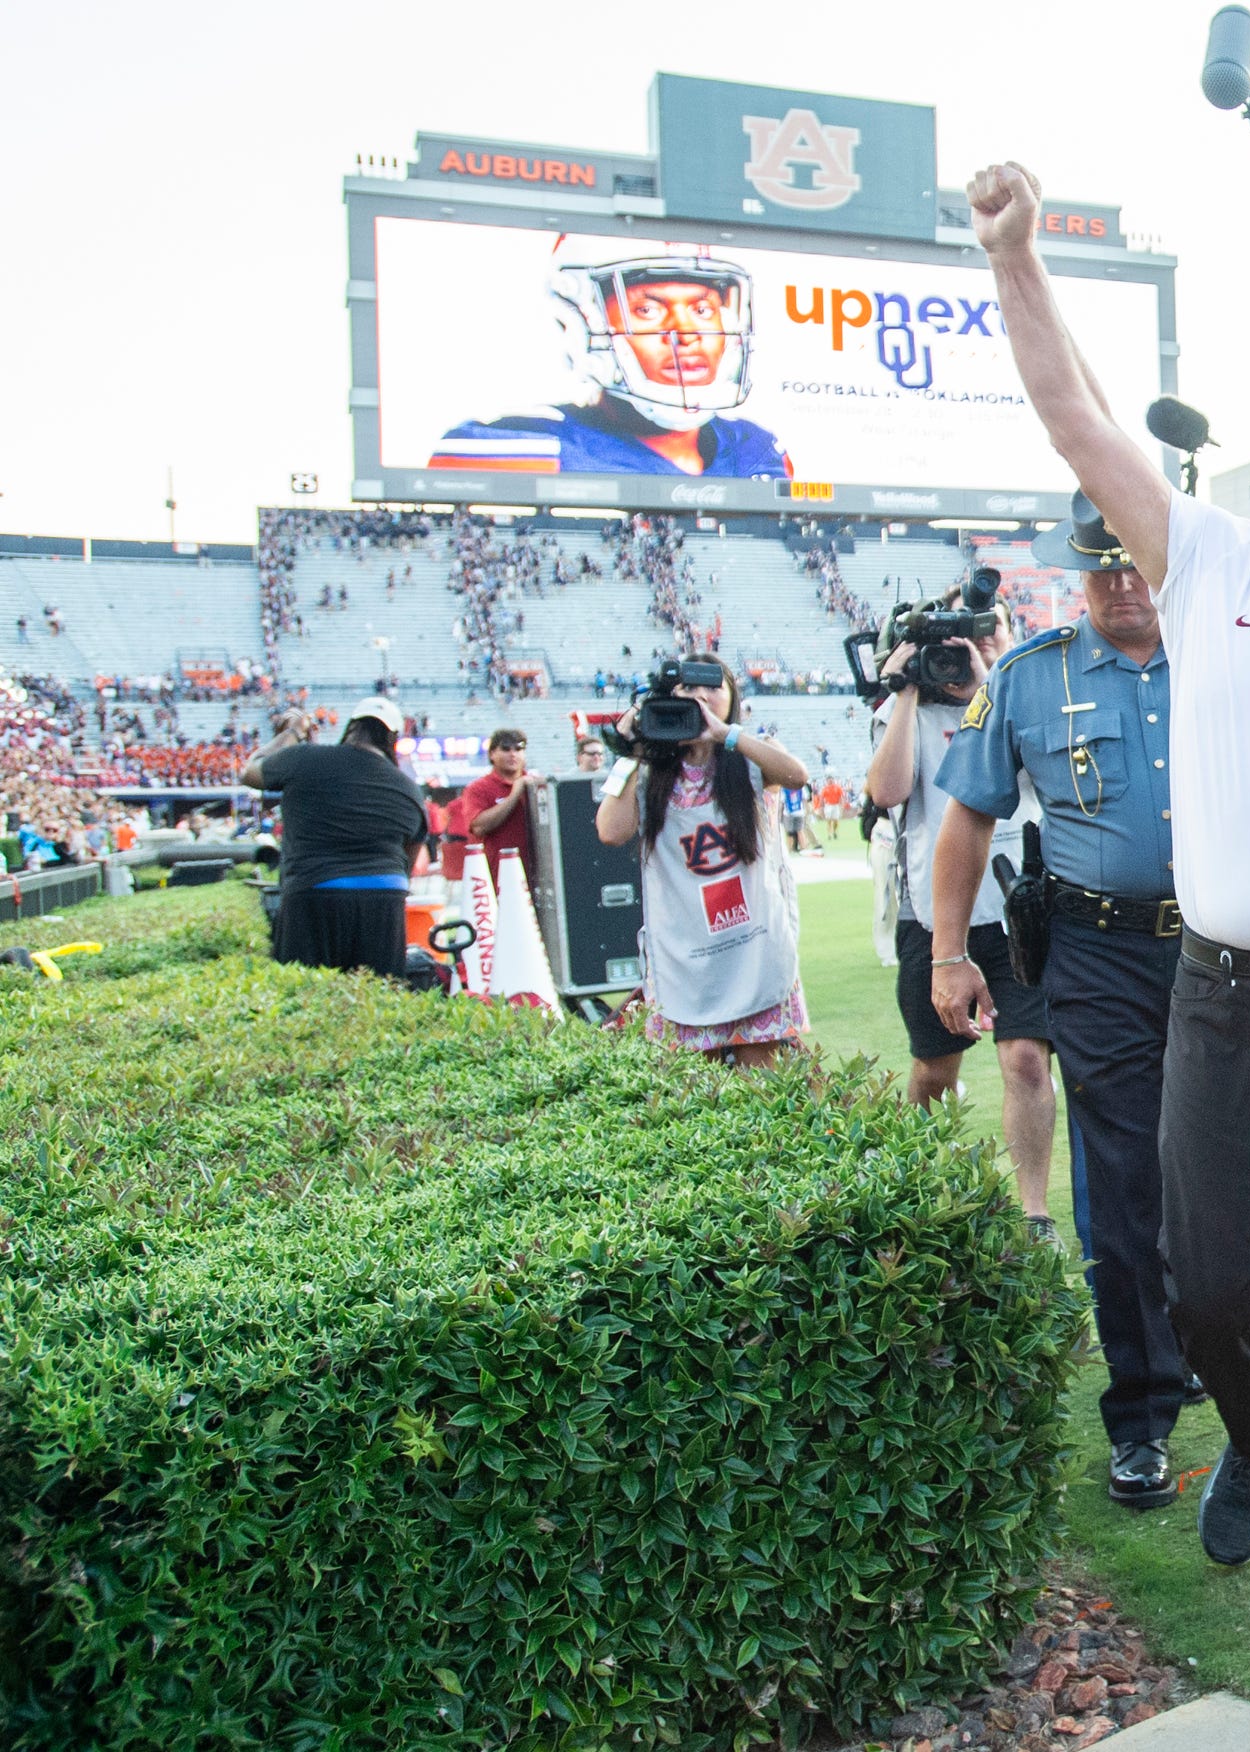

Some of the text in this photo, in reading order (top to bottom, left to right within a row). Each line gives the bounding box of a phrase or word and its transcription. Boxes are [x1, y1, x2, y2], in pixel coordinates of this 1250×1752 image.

[439, 149, 597, 188] AUBURN
[1035, 212, 1107, 238] ERS
[876, 322, 934, 389] OU
[781, 381, 880, 398] FOOTBALL
[923, 388, 1027, 406] OKLAHOMA
[713, 903, 748, 928] ALFA
